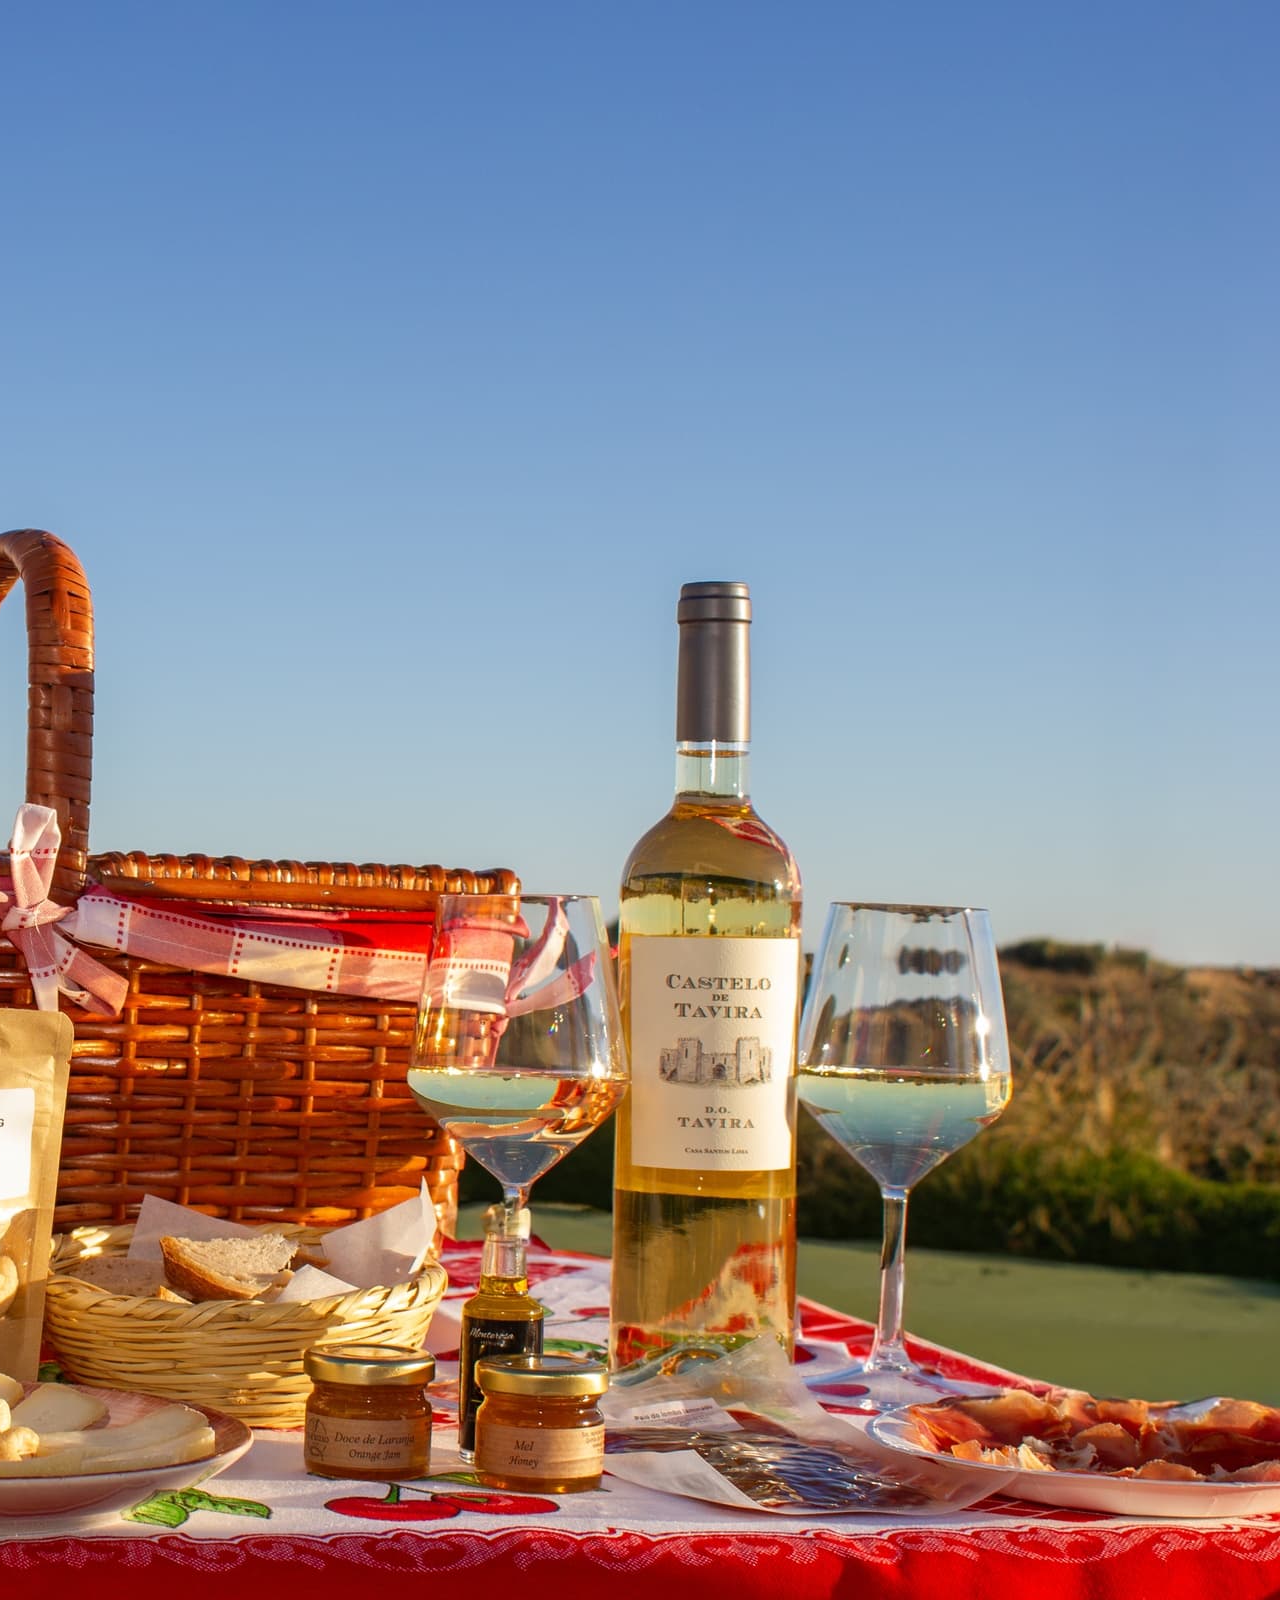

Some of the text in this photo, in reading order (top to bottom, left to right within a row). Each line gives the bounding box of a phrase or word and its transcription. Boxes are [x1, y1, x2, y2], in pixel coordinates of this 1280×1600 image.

[665, 974, 771, 990] CASTELO
[674, 1003, 762, 1018] TAVIRA
[705, 1106, 730, 1114] D.O.
[677, 1117, 755, 1128] TAVIRA
[334, 1432, 360, 1443] Doce
[363, 1434, 376, 1444] de
[378, 1434, 415, 1446] Laranja
[514, 1440, 534, 1452] Mel
[348, 1449, 400, 1462] Orange Jam
[508, 1456, 538, 1469] Honey
